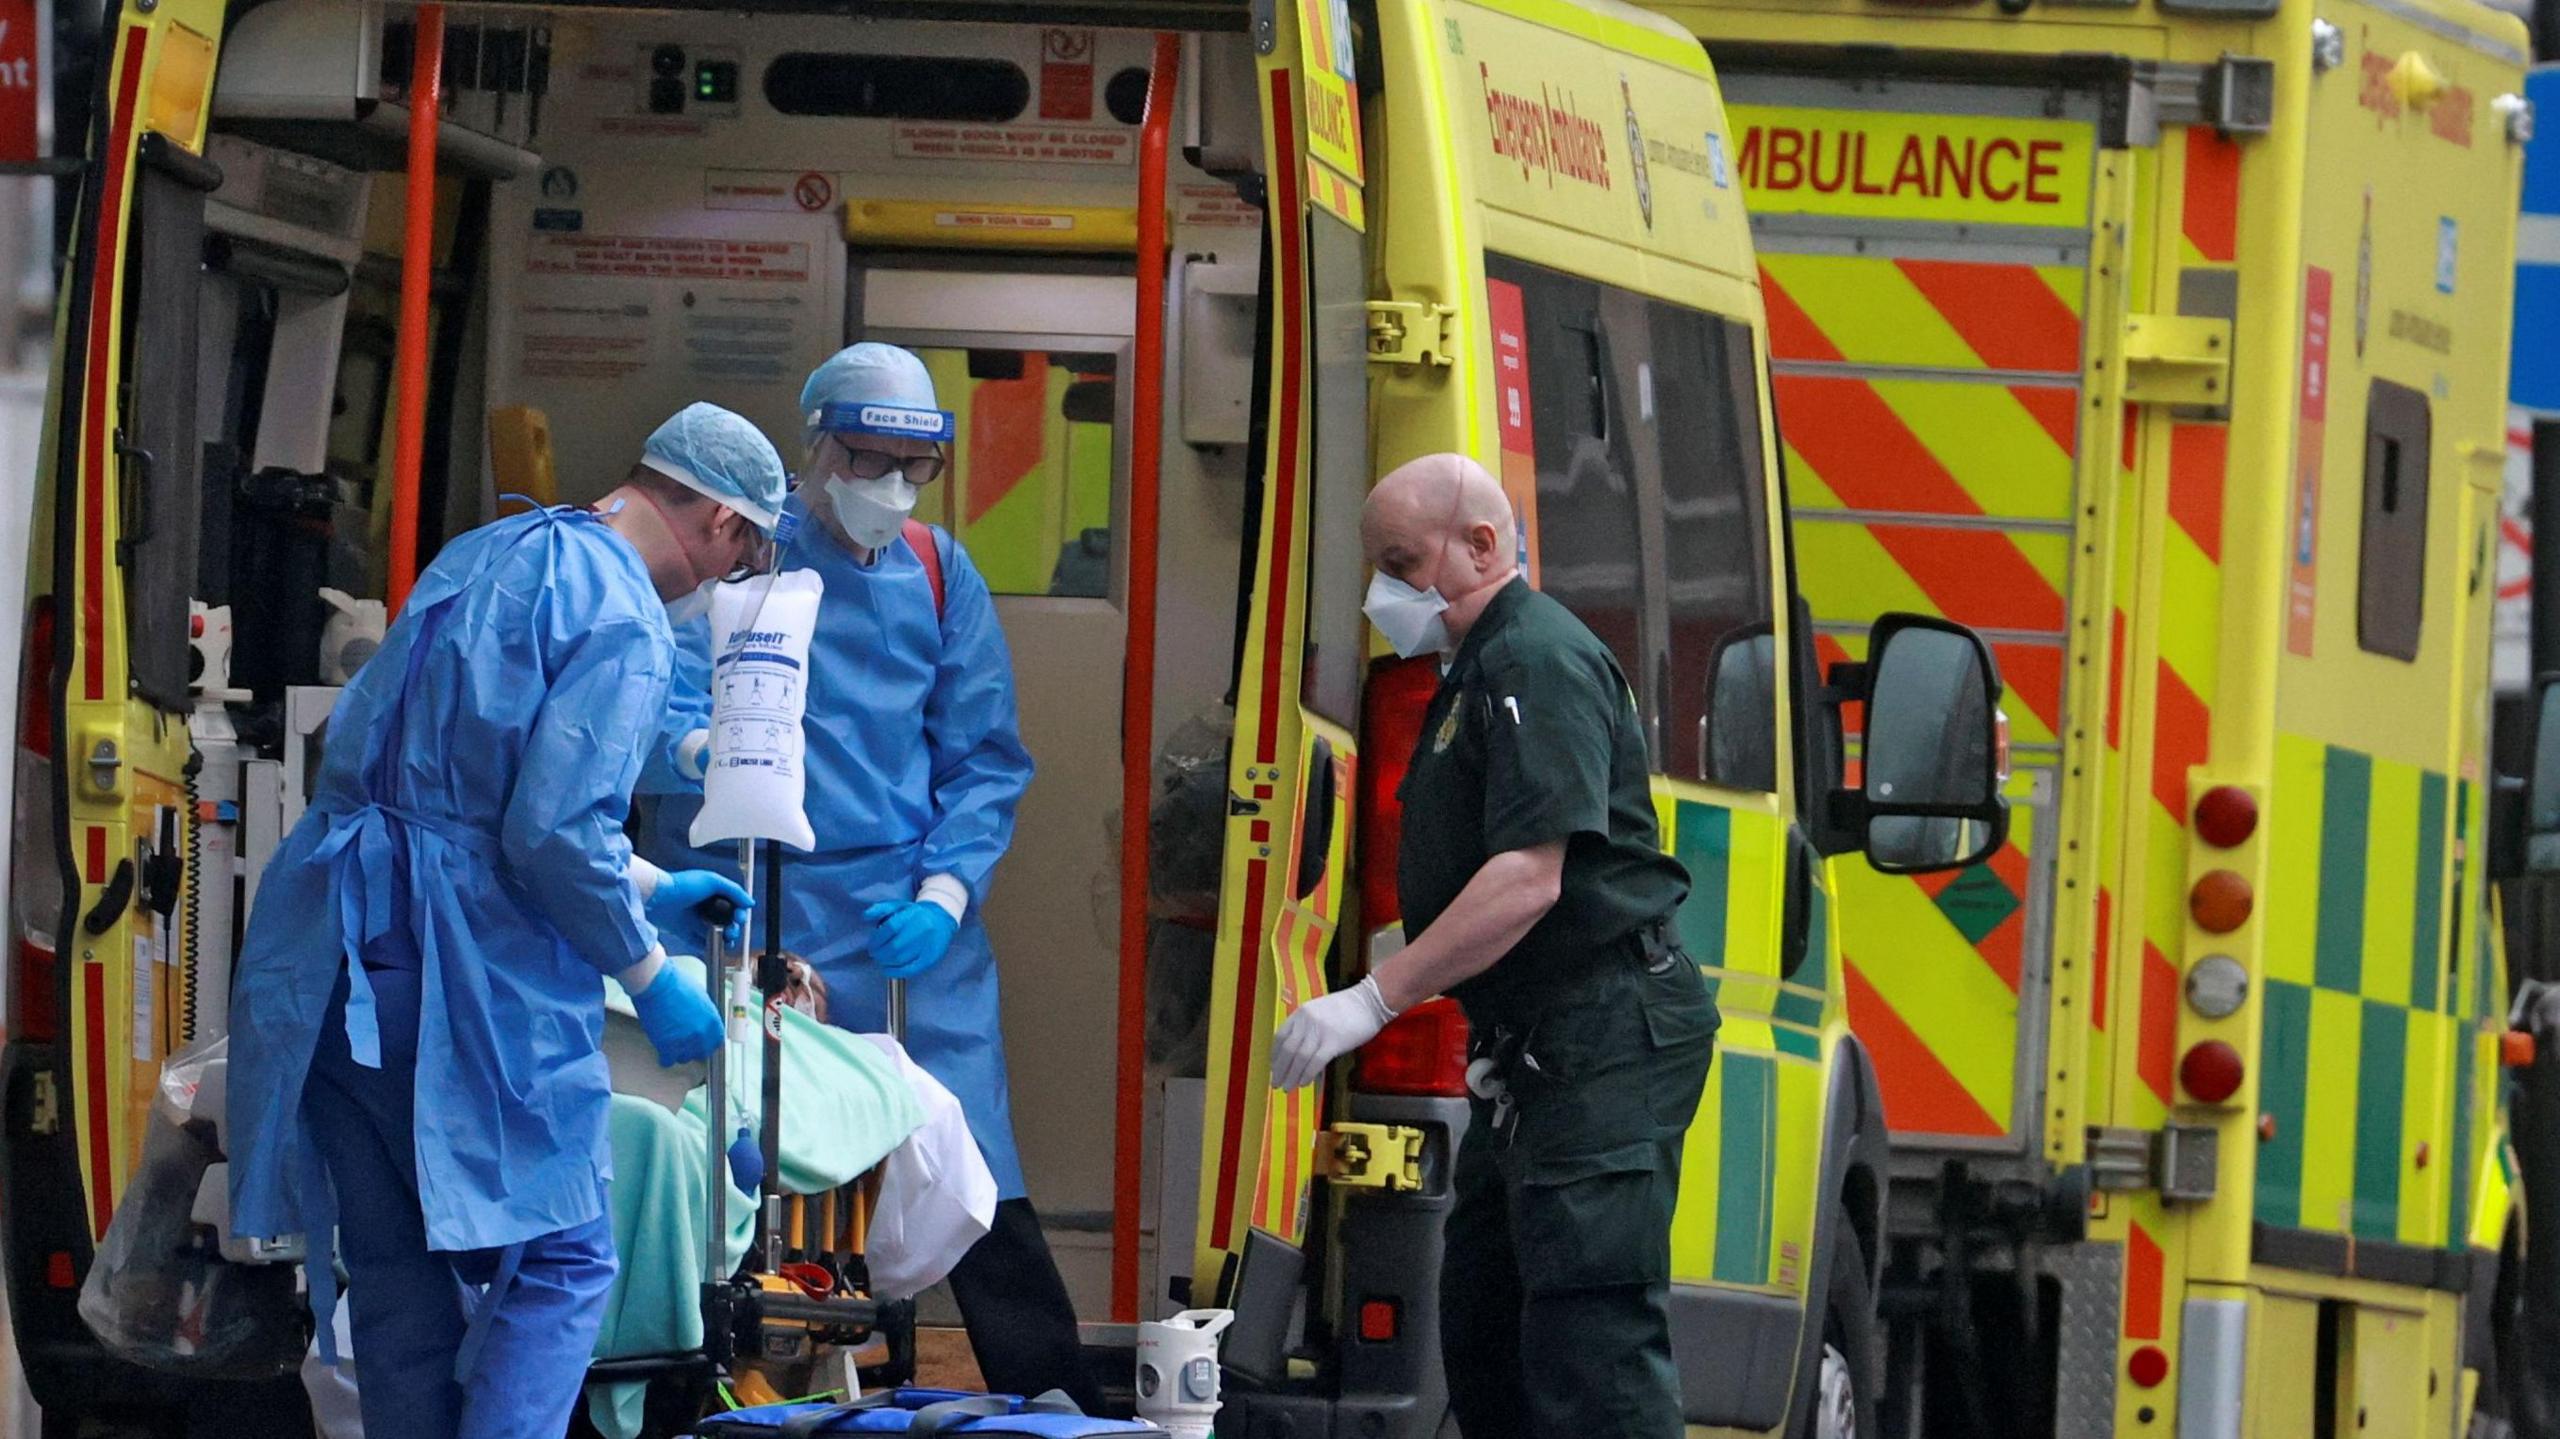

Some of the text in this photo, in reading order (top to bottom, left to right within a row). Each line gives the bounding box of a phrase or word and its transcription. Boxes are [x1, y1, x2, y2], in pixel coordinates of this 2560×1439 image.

[1480, 61, 1552, 189] Emergency
[1542, 80, 1610, 191] Ambulance
[1072, 134, 1127, 146] CLOSED
[912, 141, 954, 152] WHEN
[959, 144, 1018, 155] VEHICLE
[1058, 148, 1115, 159] MOTION
[866, 411, 897, 424] Face
[903, 413, 940, 428] Shield
